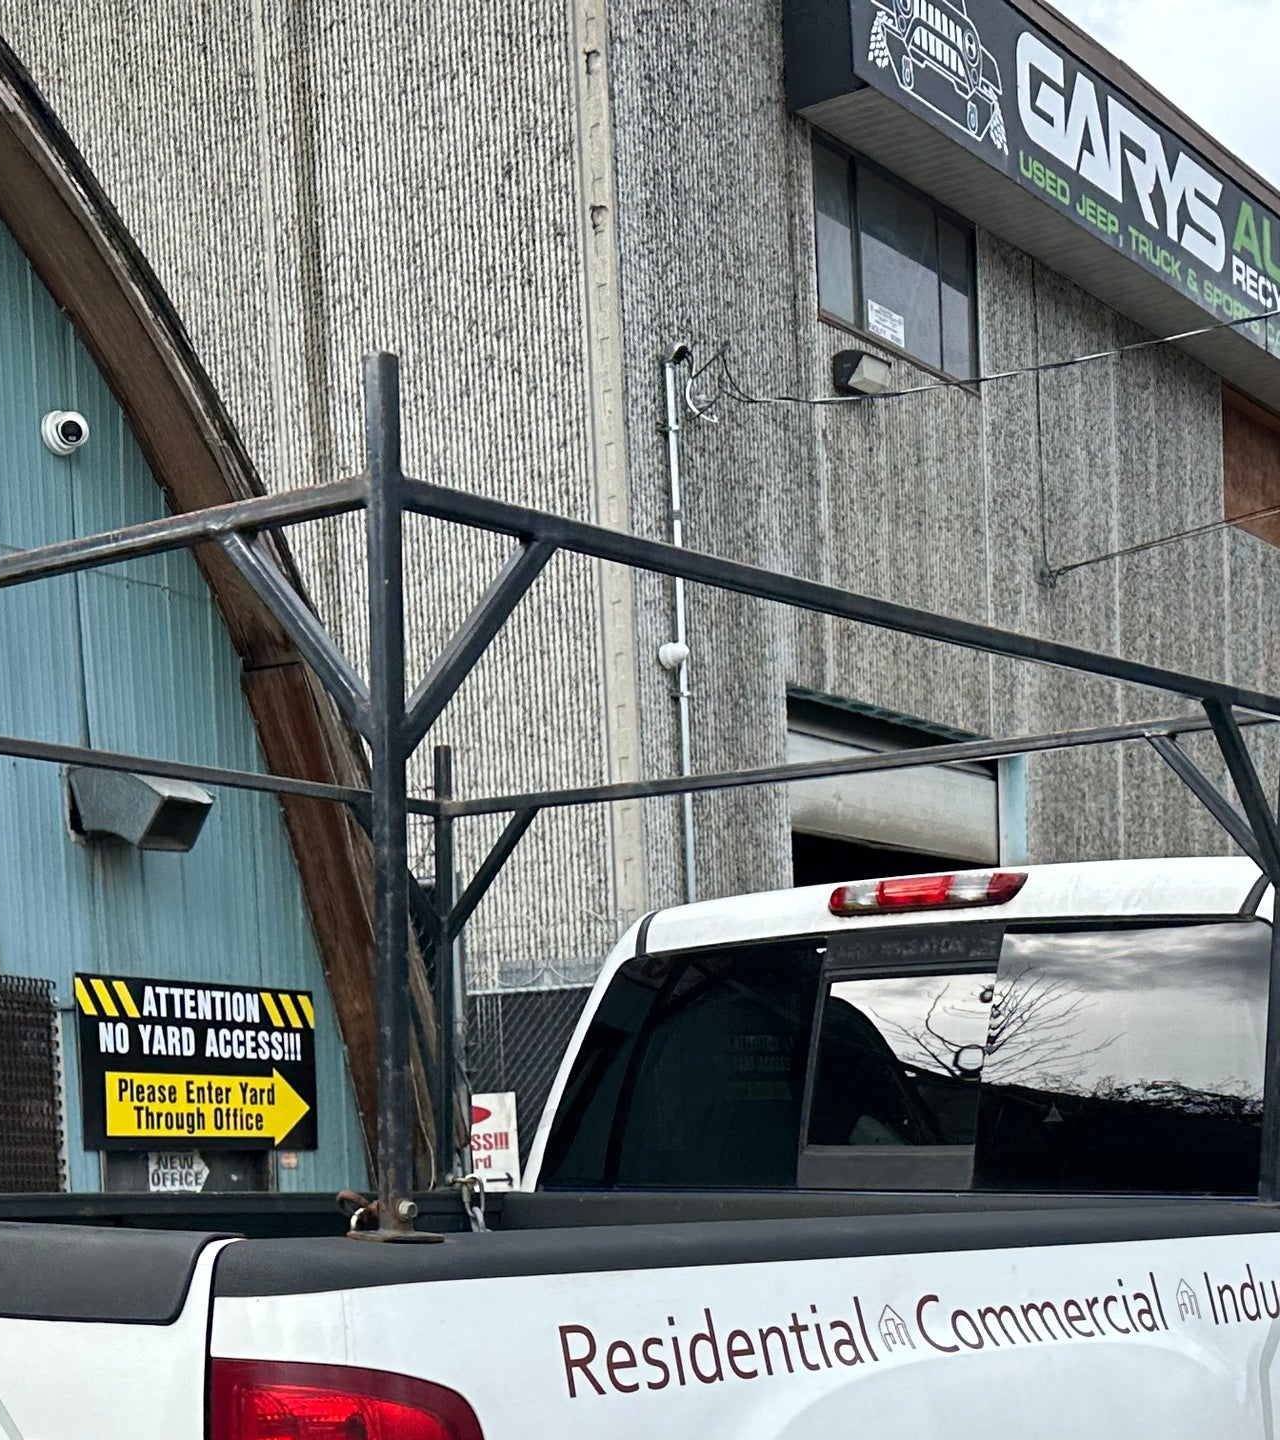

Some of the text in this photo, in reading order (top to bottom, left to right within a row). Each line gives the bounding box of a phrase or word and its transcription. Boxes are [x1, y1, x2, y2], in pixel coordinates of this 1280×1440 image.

[1016, 31, 1226, 273] GARYS
[1019, 150, 1070, 206] USED
[1128, 225, 1182, 281] TRUCK
[1186, 268, 1199, 294] &
[1203, 279, 1260, 336] SPORTS
[142, 985, 261, 1023] ATTENTION
[98, 1021, 302, 1061] NO YARD ACCESS!!!
[118, 1078, 276, 1106] Please Enter Yard
[133, 1106, 264, 1134] Through Office
[151, 1170, 203, 1187] OFFICE
[155, 1155, 194, 1171] NEW
[557, 1295, 880, 1398] Residential
[916, 1271, 1168, 1355] Commercial
